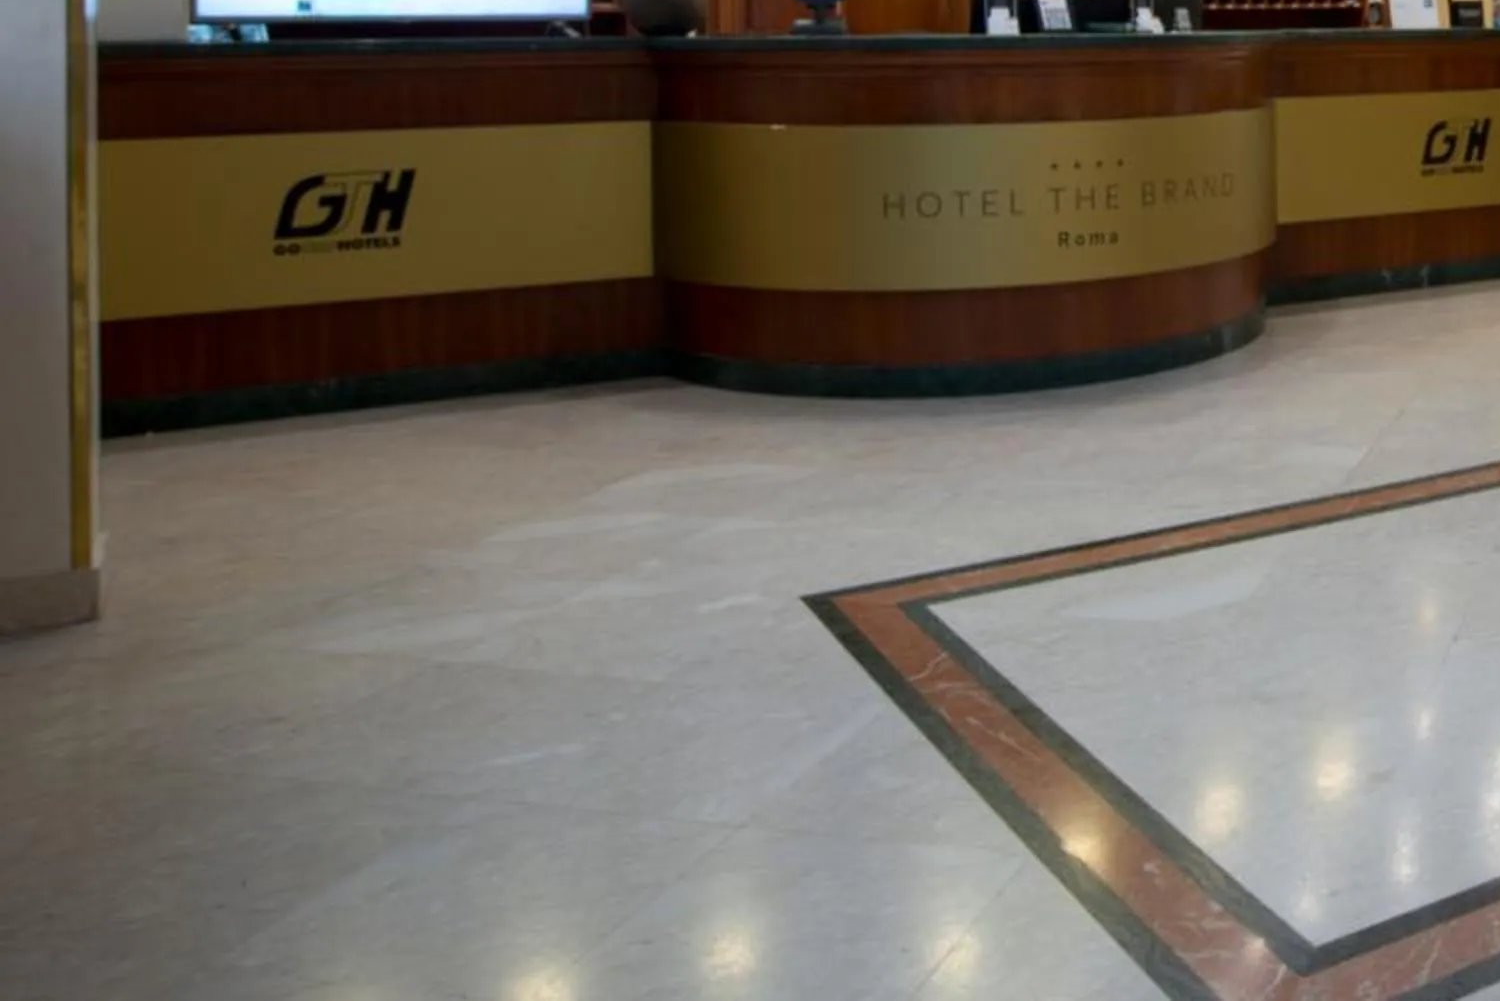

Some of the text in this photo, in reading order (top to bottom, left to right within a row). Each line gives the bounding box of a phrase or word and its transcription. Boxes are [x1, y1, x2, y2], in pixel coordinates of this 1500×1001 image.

[1421, 117, 1491, 165] GH
[882, 173, 1236, 219] HOTEL THE BRAND
[1057, 230, 1120, 248] Roma
